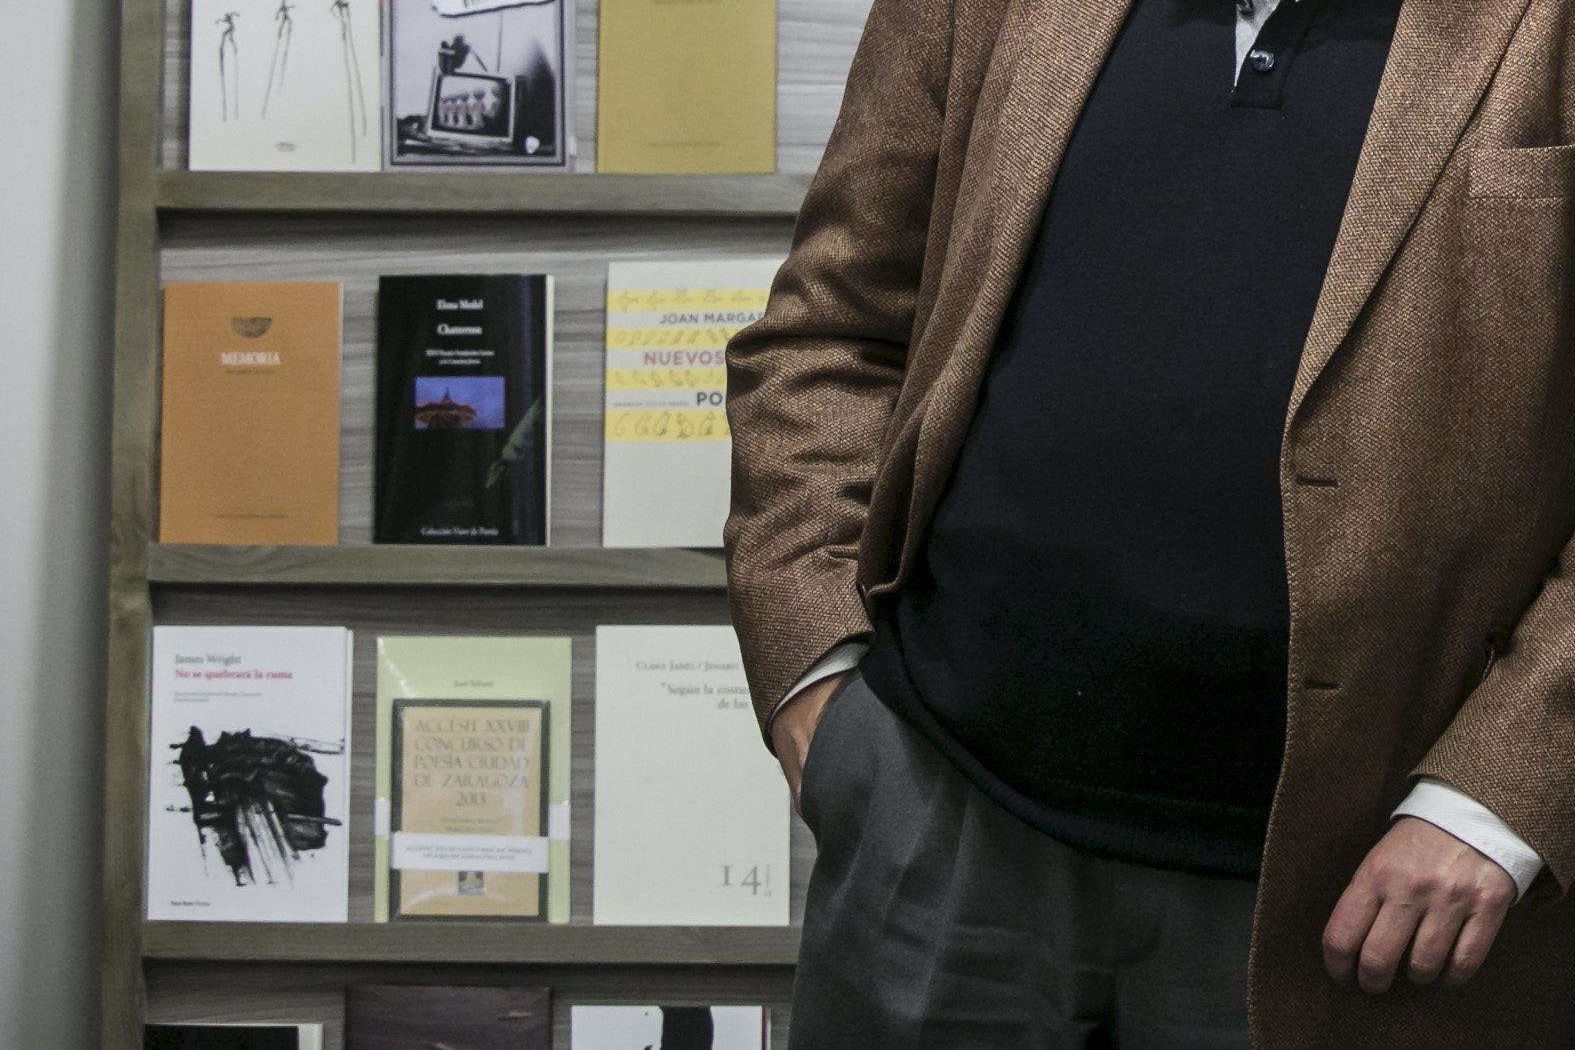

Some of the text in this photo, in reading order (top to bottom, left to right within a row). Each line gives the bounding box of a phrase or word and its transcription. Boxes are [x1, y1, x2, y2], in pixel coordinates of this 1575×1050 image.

[660, 313, 699, 325] JOAN
[220, 351, 280, 366] MEMORIA
[644, 350, 724, 366] NUEVOS
[175, 669, 191, 678] No
[703, 683, 714, 694] la
[717, 697, 729, 709] de
[442, 773, 529, 788] ZARAGOZA
